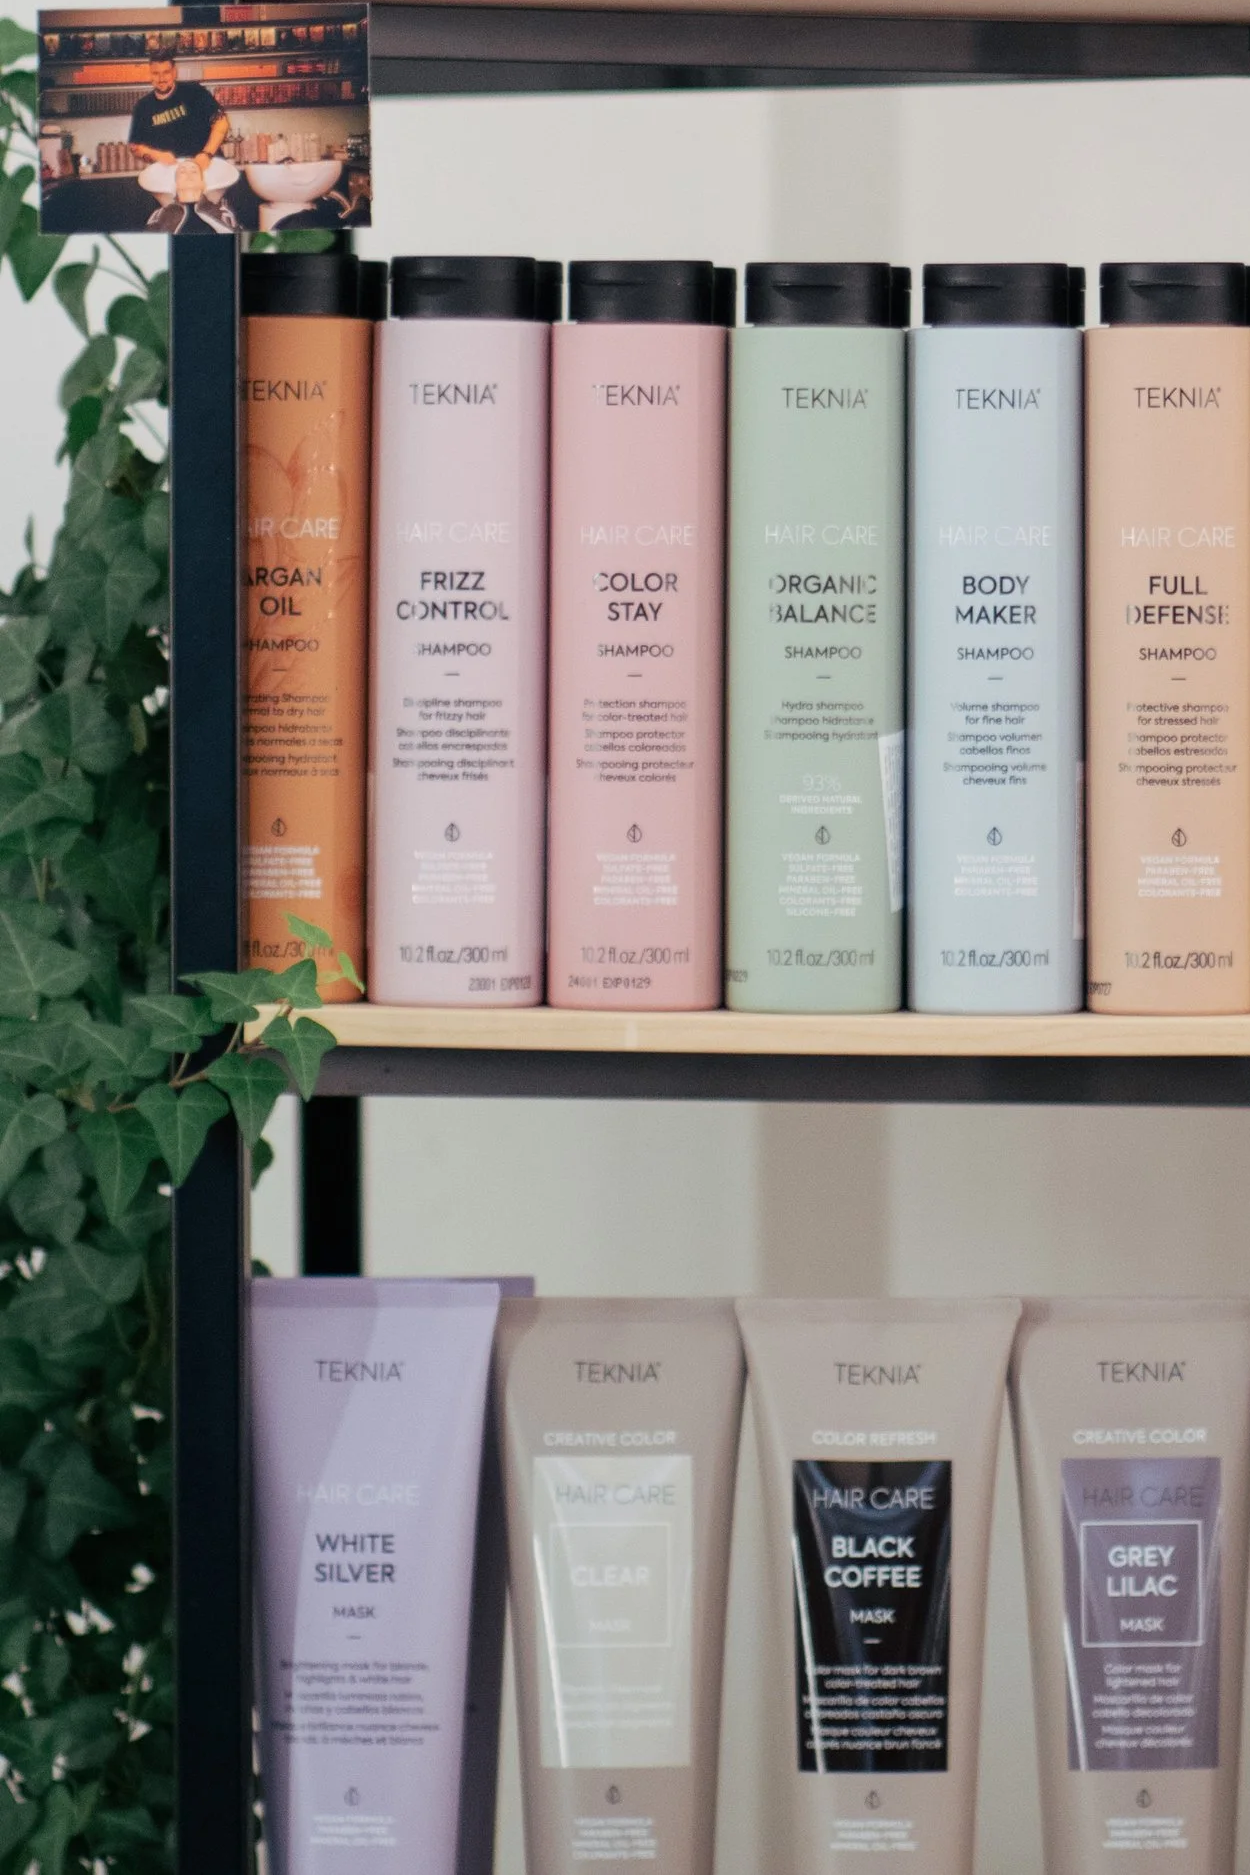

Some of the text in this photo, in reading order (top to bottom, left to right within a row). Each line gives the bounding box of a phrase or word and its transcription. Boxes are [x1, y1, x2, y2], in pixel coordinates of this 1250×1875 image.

[1120, 525, 1236, 550] HAIR CARE
[418, 570, 486, 592] FRIZZ
[961, 574, 1030, 597] BODY
[1148, 574, 1208, 597] FULL
[259, 595, 302, 619] OIL
[606, 600, 664, 623] STAY
[954, 603, 1038, 627] MAKER
[783, 644, 863, 661] SHAMPOO
[955, 645, 1035, 662] SHAMPOO
[1138, 645, 1218, 662] SHAMPOO
[542, 1429, 677, 1449] CREATIVE COLOR
[811, 1429, 938, 1447] COLOR REFRESH
[315, 1531, 397, 1555] WHITE
[830, 1535, 915, 1559] BLACK
[1107, 1545, 1175, 1569] GREY
[313, 1561, 397, 1584] SILVER
[823, 1564, 924, 1589] COFFEE
[1105, 1572, 1179, 1598] LILAC
[332, 1604, 377, 1620] MASK
[849, 1609, 895, 1625] MASK
[1118, 1617, 1166, 1634] MASK
